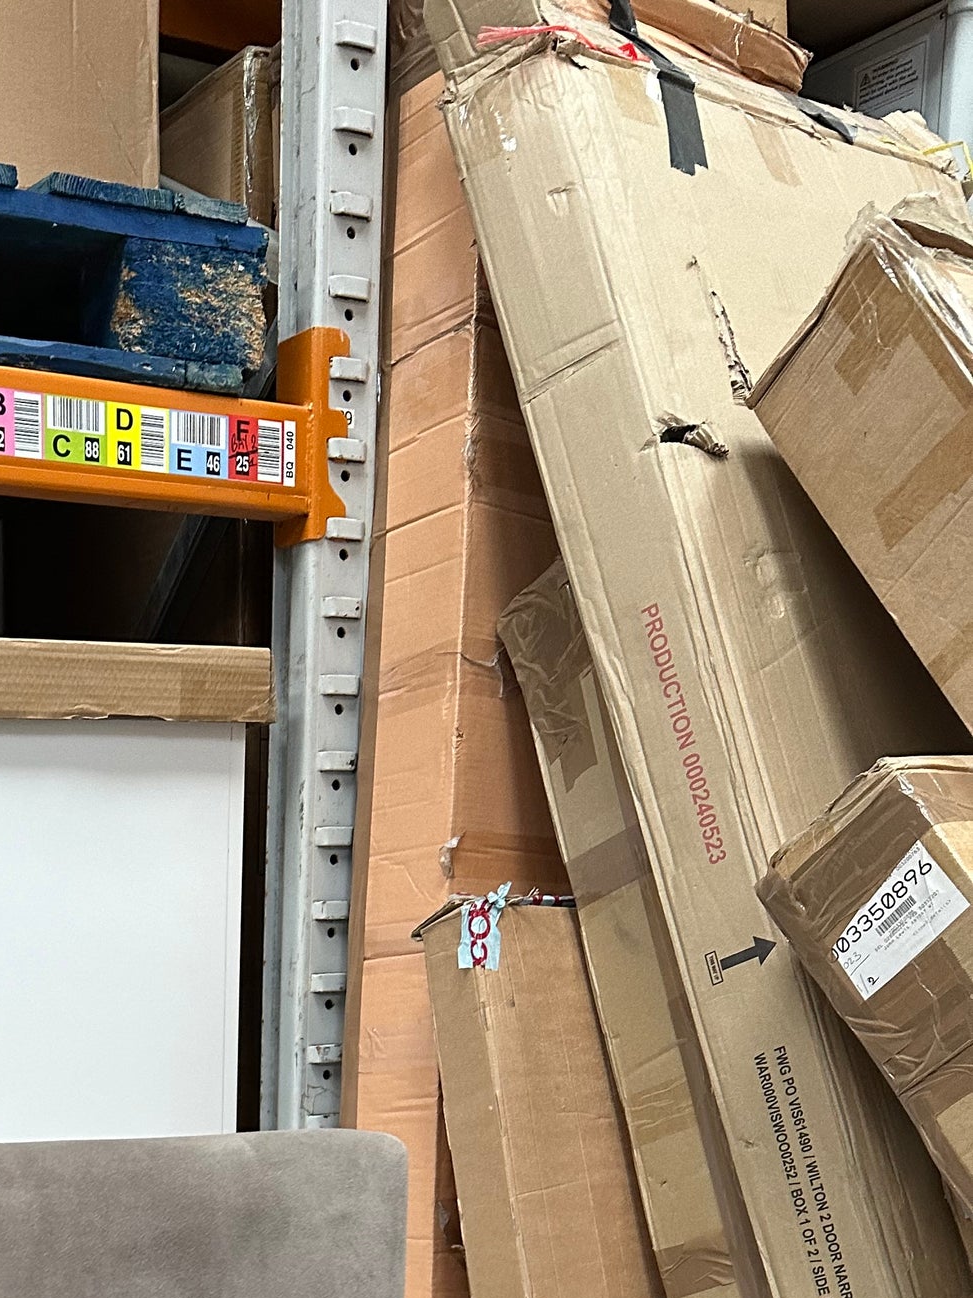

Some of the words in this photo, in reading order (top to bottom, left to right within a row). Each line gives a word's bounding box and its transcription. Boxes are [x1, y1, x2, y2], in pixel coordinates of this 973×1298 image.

[116, 408, 133, 431] D
[236, 420, 250, 441] F
[52, 434, 71, 457] C
[85, 441, 99, 459] 88
[286, 431, 294, 450] 040
[118, 444, 131, 462] 61
[177, 448, 193, 472] E
[207, 454, 220, 473] 46
[236, 455, 249, 473] 25
[286, 462, 294, 478] BQ
[641, 602, 696, 751] PRODUCTION
[682, 753, 727, 864] 000240523
[774, 1045, 791, 1076] FWG
[783, 1076, 797, 1096] PO
[788, 1096, 813, 1153] VIS61490
[806, 1160, 829, 1212] WILTON
[791, 1188, 808, 1217] BOX
[799, 1218, 811, 1226] 1
[819, 1213, 832, 1222] 2
[802, 1228, 817, 1246] OF
[822, 1223, 842, 1263] DOOR
[807, 1248, 819, 1257] 2
[812, 1265, 830, 1296] SIDE
